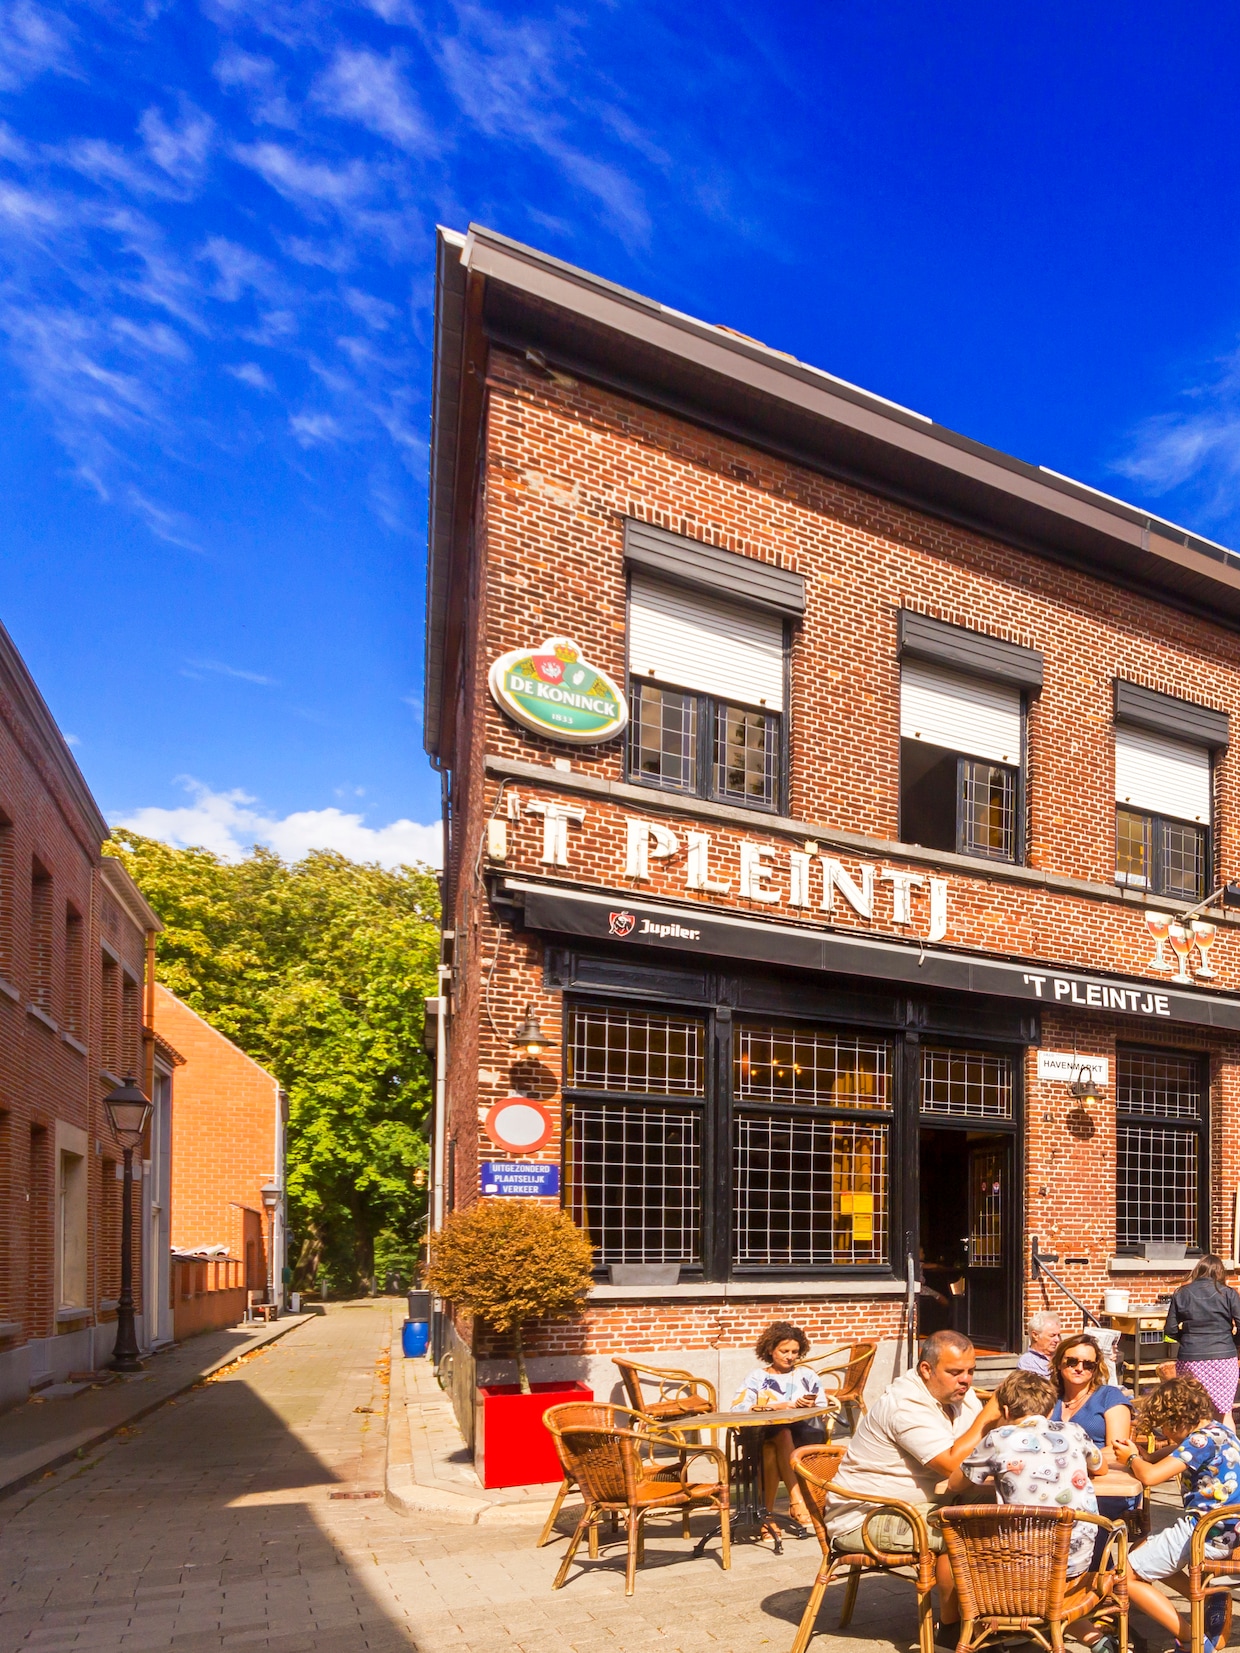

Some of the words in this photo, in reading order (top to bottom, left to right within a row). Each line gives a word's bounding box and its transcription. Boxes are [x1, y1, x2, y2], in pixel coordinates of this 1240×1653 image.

[510, 675, 534, 695] DE
[537, 683, 616, 717] KONINCK
[551, 713, 574, 725] 1833
[624, 816, 950, 942] PLEINTJ
[1023, 974, 1047, 998] 'T
[1053, 979, 1171, 1016] PLEINTJE
[1043, 1060, 1103, 1073] HAVENMARKT
[492, 1164, 551, 1173] UITGEZONDERD
[494, 1174, 545, 1183] PLAATSELIJK
[502, 1185, 539, 1193] VERKEER
